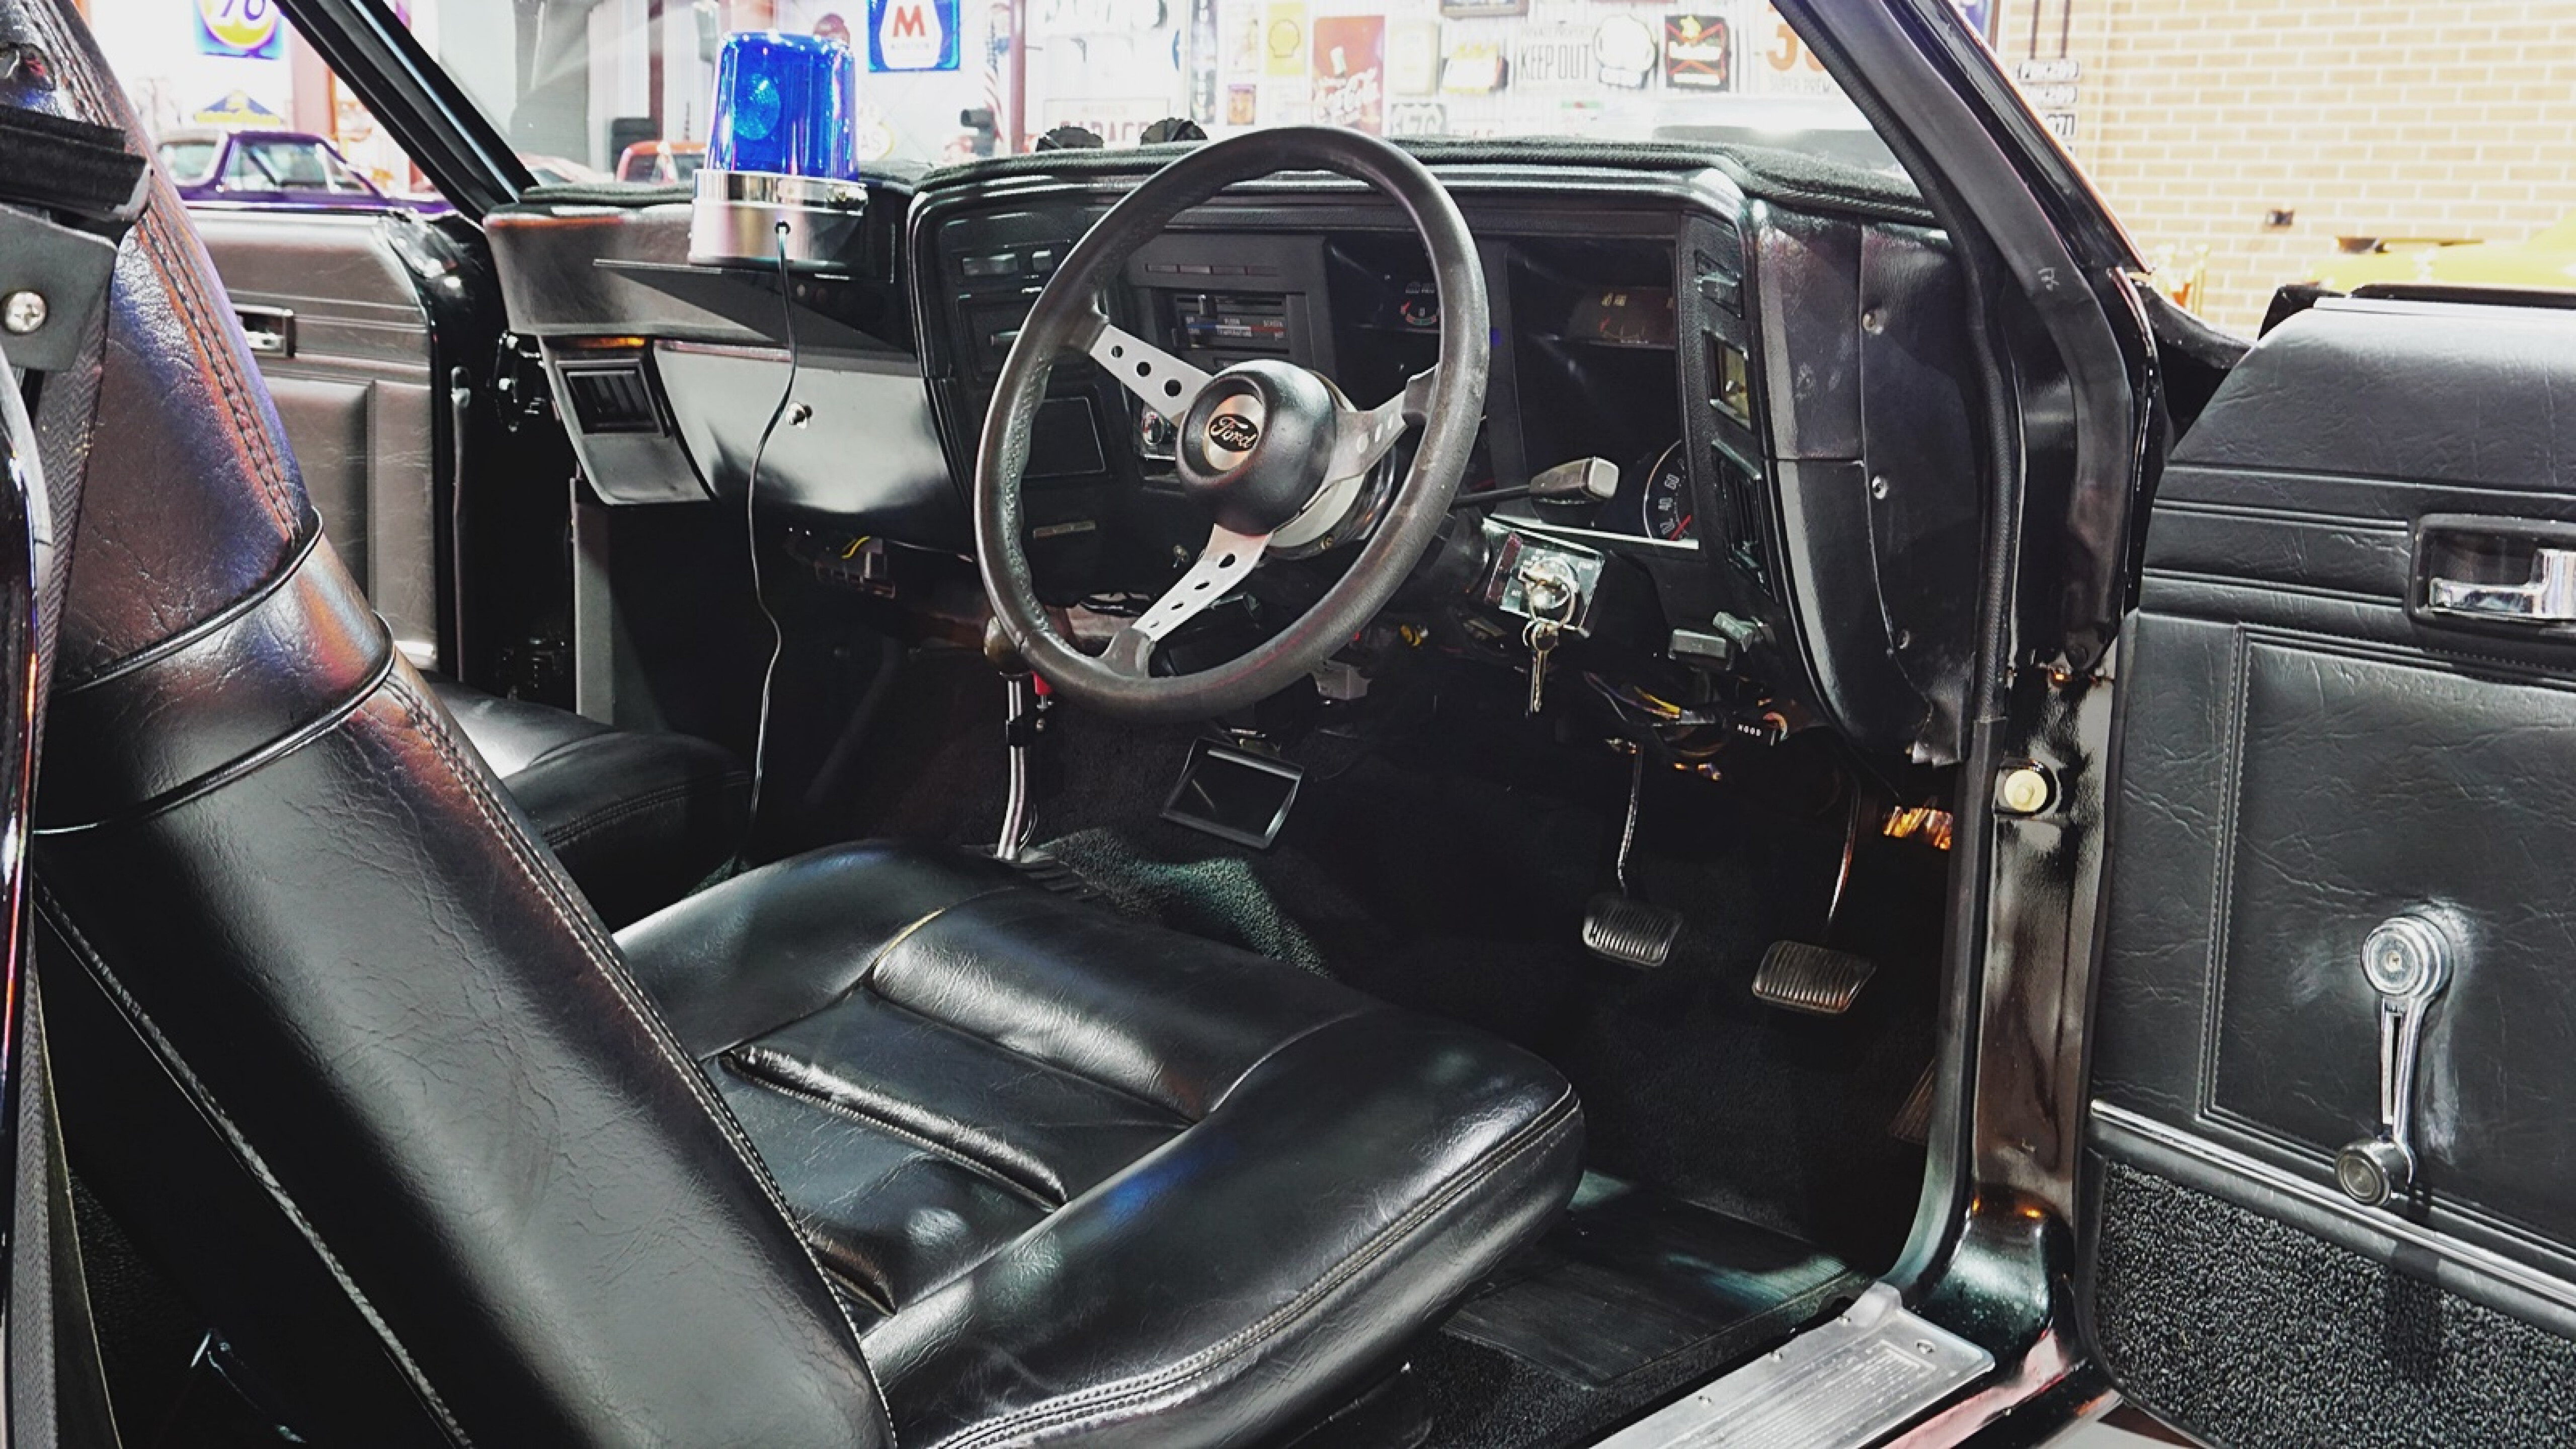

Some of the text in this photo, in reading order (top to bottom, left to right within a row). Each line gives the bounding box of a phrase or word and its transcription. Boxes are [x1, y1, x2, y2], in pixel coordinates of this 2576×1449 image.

[892, 5, 926, 38] M
[1521, 44, 1590, 80] KEEP OUT
[1210, 417, 1257, 448] Ford
[1664, 473, 1680, 490] 60
[1658, 497, 1674, 511] 40
